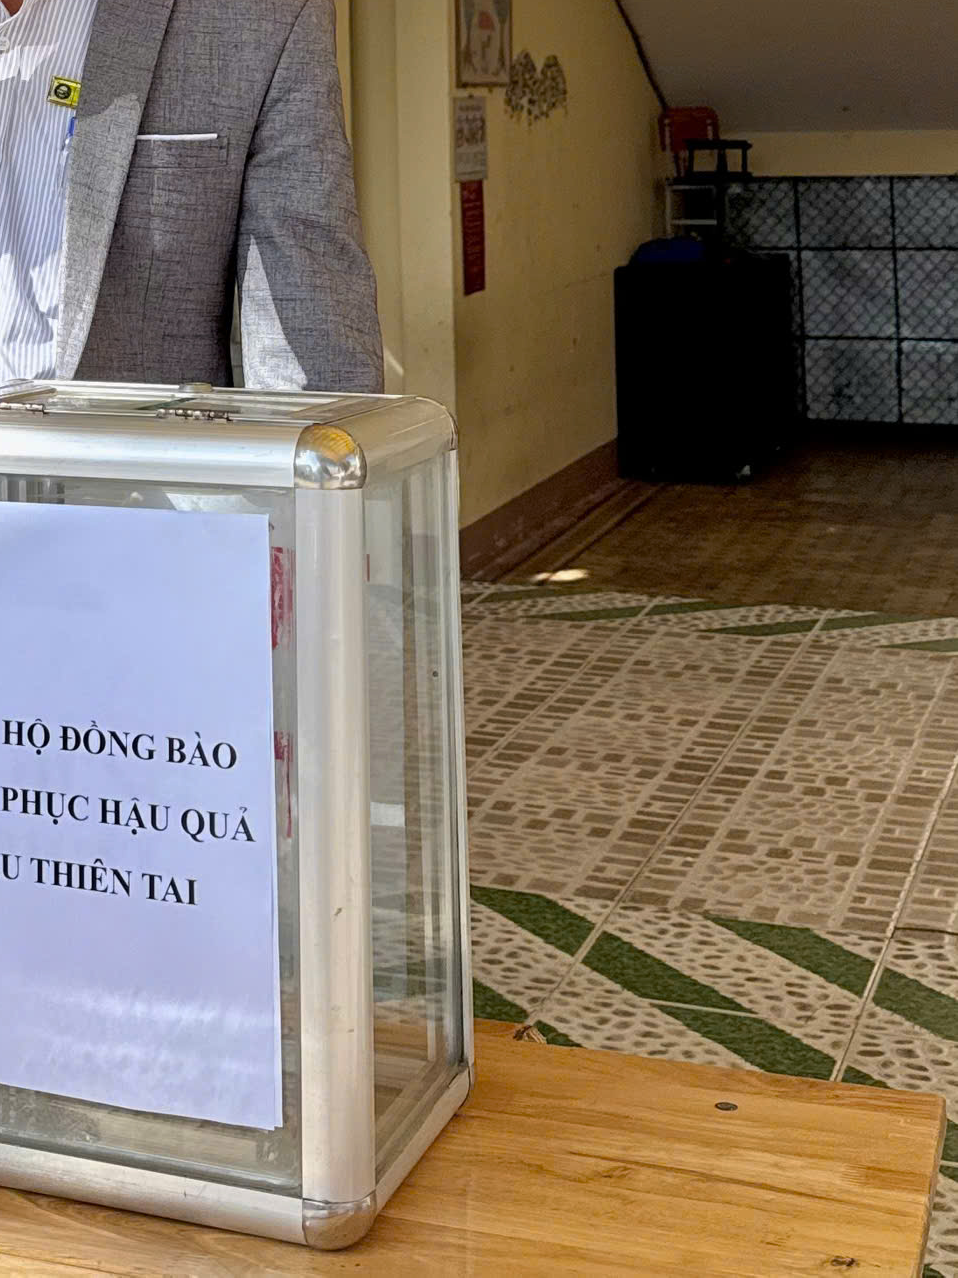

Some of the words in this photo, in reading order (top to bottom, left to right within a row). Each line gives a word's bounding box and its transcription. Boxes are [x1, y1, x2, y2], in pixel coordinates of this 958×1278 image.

[2, 718, 50, 755] HỘ
[59, 720, 156, 760] ĐỒNG
[166, 731, 237, 769] BÀO
[1, 786, 89, 825] PHỤC
[98, 797, 171, 835] HẬU
[181, 807, 256, 842] QUẢ
[30, 858, 132, 897] THIÊN
[142, 873, 198, 905] TAI
